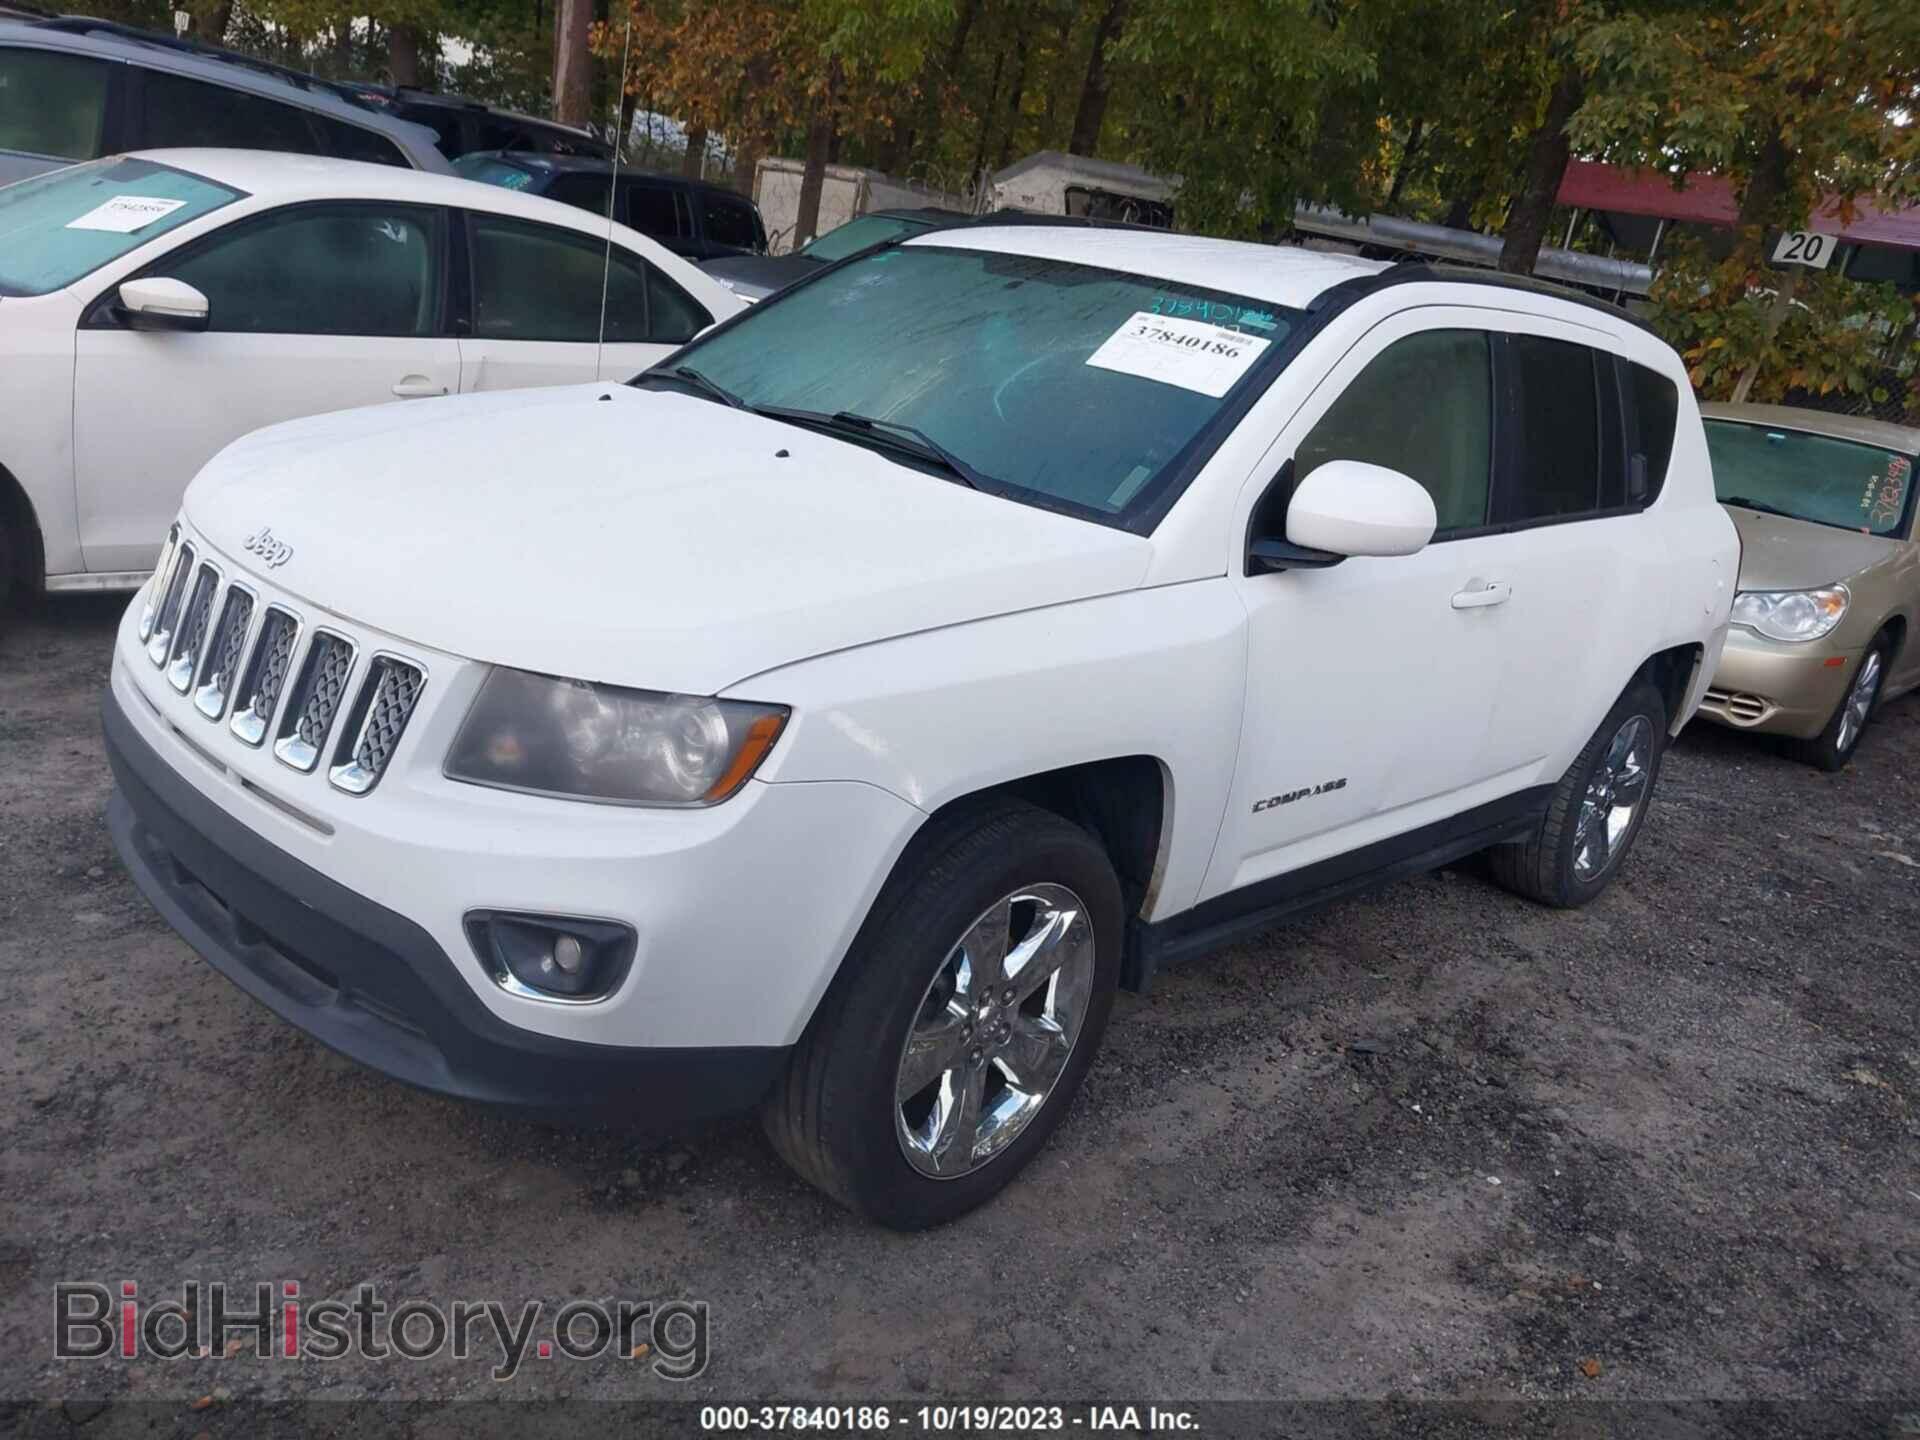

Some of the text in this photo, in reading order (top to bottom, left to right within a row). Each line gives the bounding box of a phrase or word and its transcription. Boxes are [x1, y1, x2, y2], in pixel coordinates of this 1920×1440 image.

[1783, 234, 1823, 261] 20
[1131, 325, 1239, 359] 37840186
[243, 527, 294, 569] Jeep
[1251, 778, 1347, 814] COMPASS
